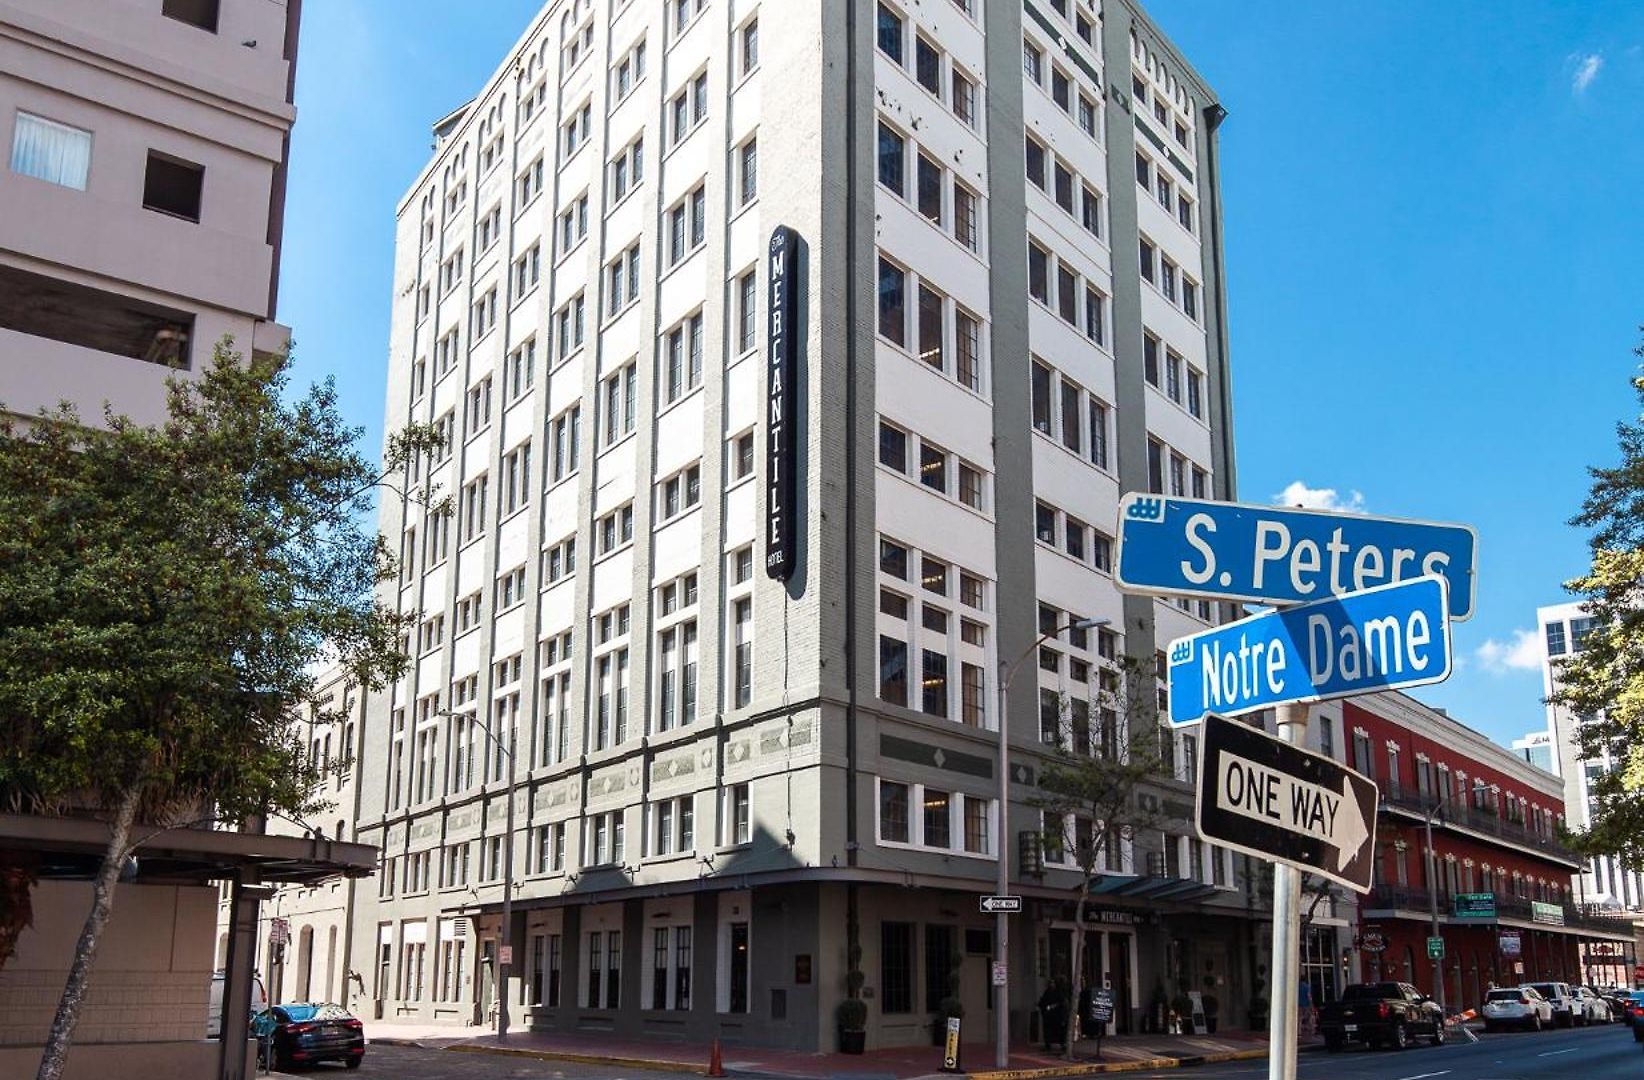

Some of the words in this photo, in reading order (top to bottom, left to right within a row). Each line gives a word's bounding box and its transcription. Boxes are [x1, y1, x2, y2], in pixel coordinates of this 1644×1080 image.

[771, 250, 784, 544] MERCANTILE
[767, 550, 785, 567] HOTEL
[1180, 512, 1232, 587] S.
[1202, 631, 1286, 709] Notre
[1307, 609, 1431, 687] Dame
[1226, 761, 1282, 820] ONE
[1290, 780, 1340, 838] WAY
